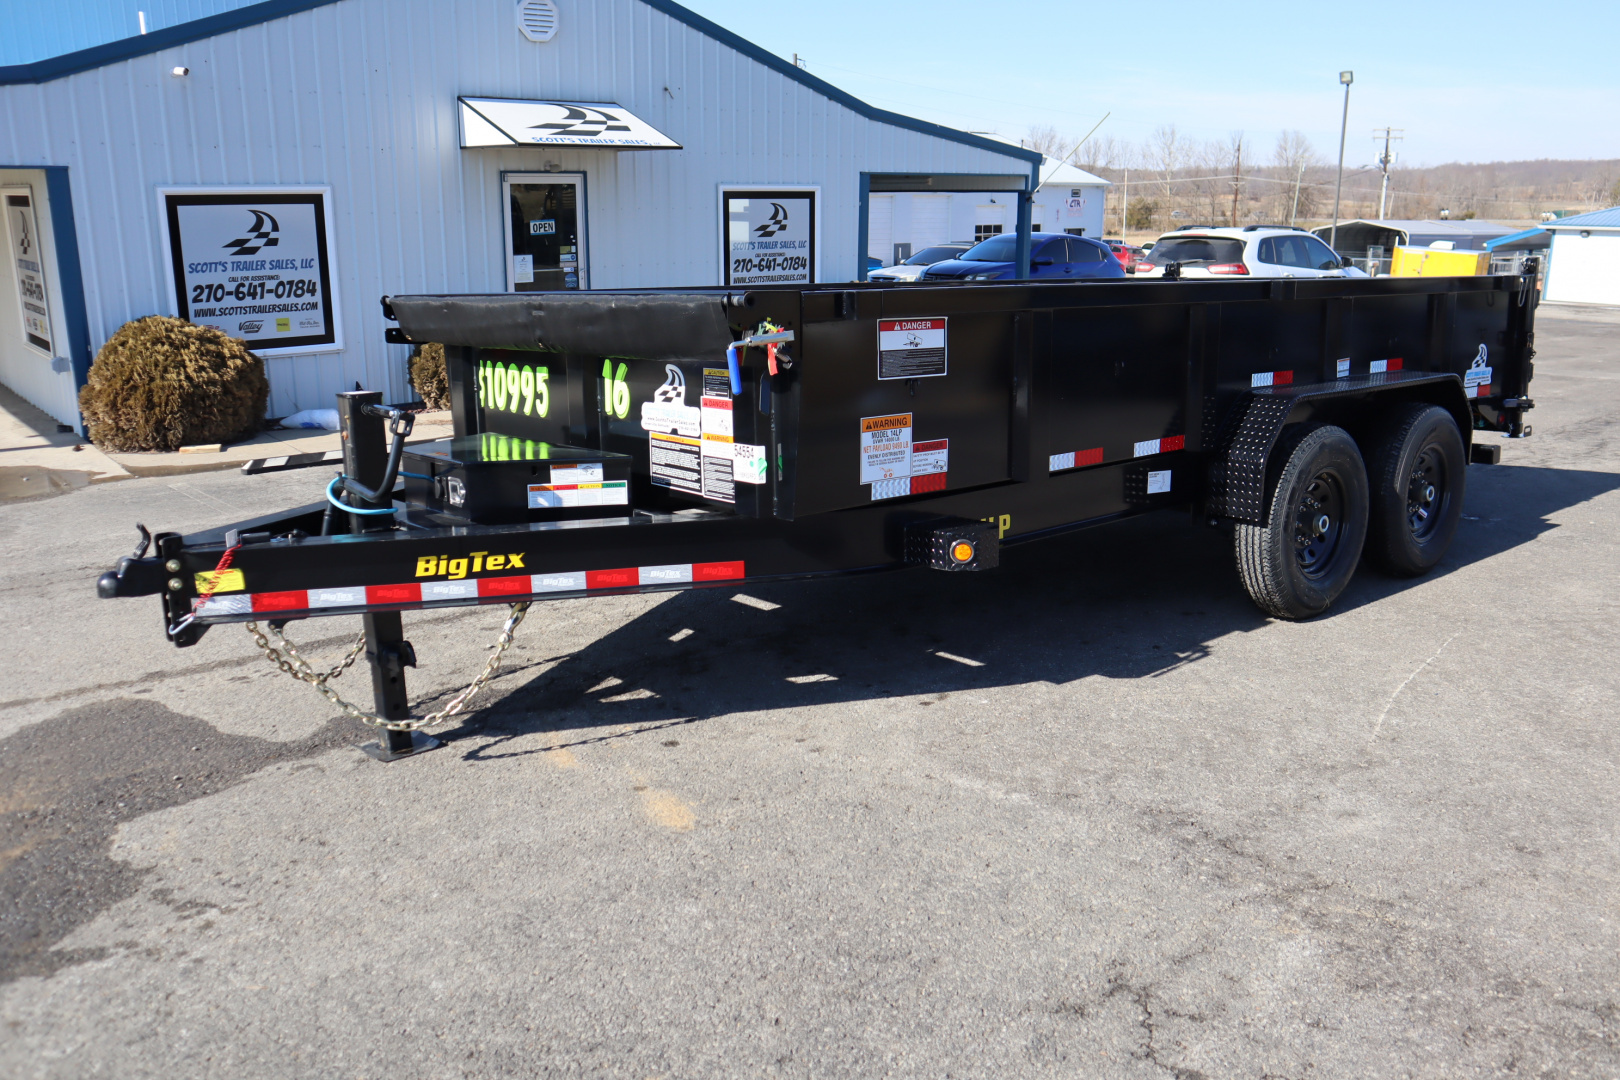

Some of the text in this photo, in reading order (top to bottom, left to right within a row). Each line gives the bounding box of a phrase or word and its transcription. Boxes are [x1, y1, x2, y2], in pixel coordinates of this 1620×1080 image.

[532, 222, 553, 232] OPEN
[733, 240, 807, 251] SCOTT'S TRAILER SALES, LLC
[188, 258, 314, 273] SCOTT'S TRAILER SALES, LLC
[733, 256, 807, 273] 270-641-0784
[733, 274, 807, 284] WWW.SCOTTSTRAILERSALES.COM
[192, 279, 317, 303] 270-641-0784
[194, 302, 318, 318] WWW.SCOTTSTRAILERSALES.COM
[238, 320, 264, 332] Valley
[902, 321, 931, 330] DANGER
[479, 360, 549, 418] $10995
[602, 358, 630, 419] 16
[709, 399, 729, 408] DANGER
[873, 417, 907, 429] WARNING
[872, 431, 888, 439] MODEL
[873, 443, 891, 452] PAYLOAD
[922, 442, 943, 450] DANGER
[734, 445, 754, 458] 54554
[415, 551, 526, 580] BigTex
[650, 570, 681, 578] BigTex
[543, 578, 574, 586] BigTex
[433, 585, 465, 594] BigTex
[320, 591, 354, 601] BigTex
